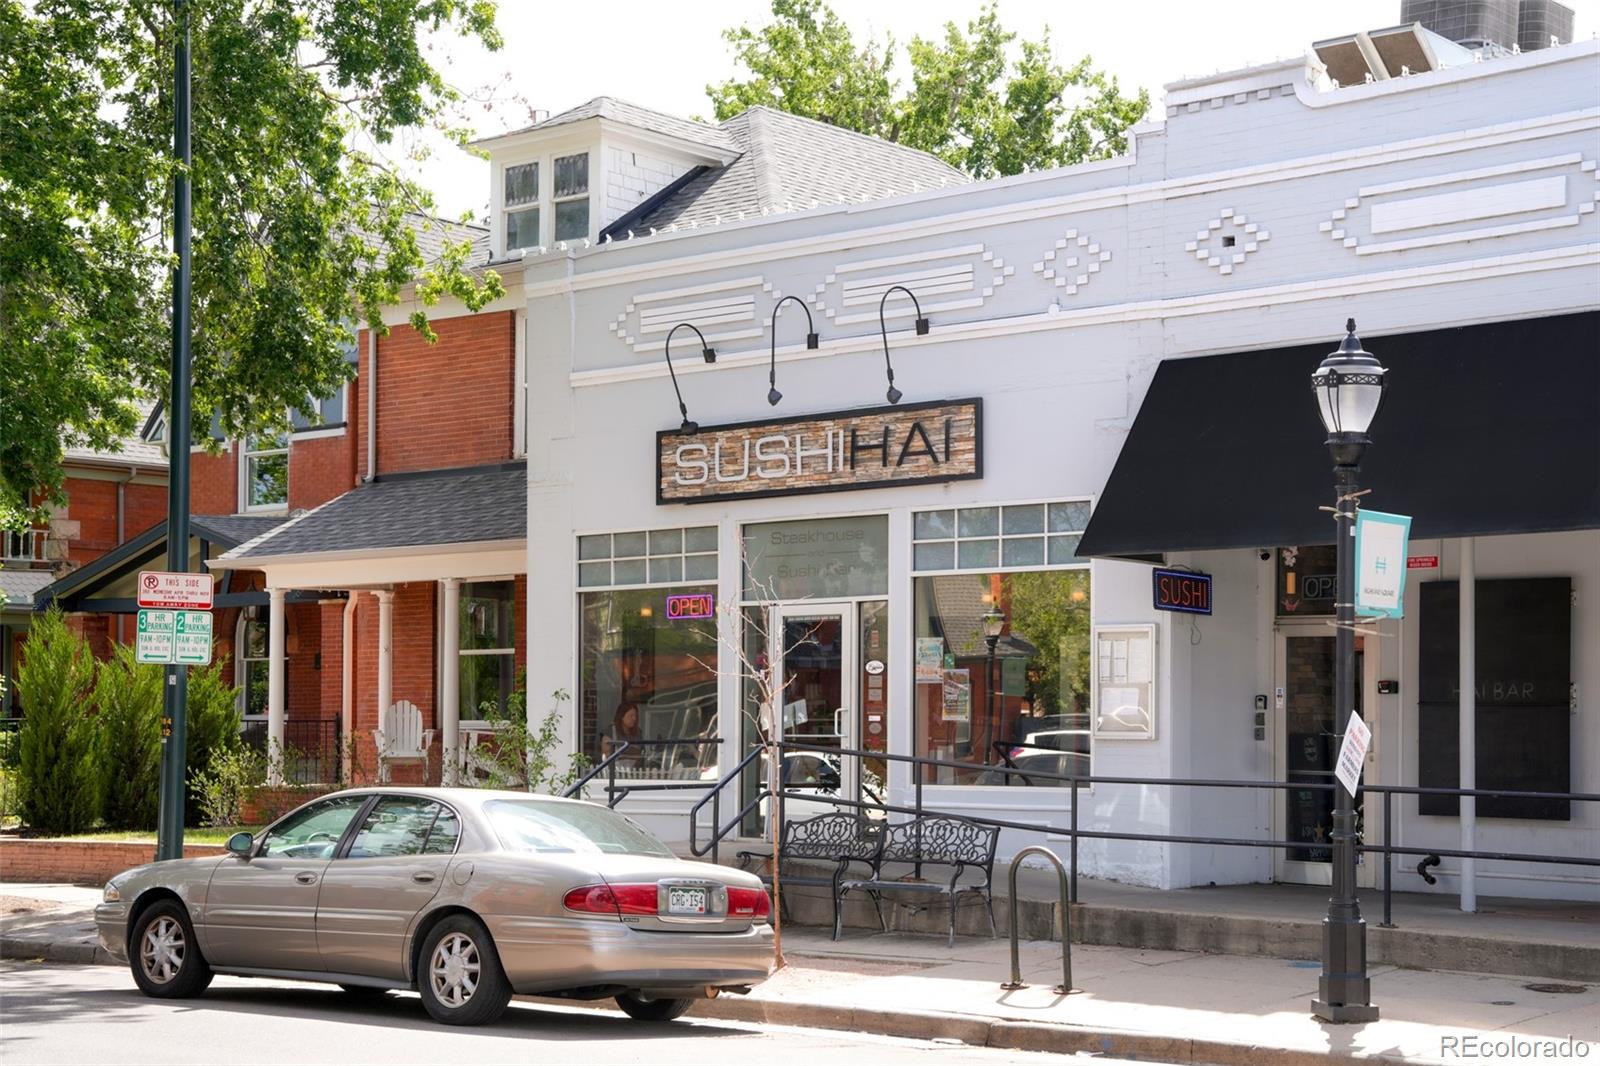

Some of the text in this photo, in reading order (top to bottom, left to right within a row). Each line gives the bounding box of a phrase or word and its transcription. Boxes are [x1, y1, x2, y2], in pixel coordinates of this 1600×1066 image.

[770, 528, 865, 545] Steakhouse
[165, 578, 199, 588] THIS SIDE
[1160, 577, 1207, 608] SUSHI
[669, 597, 710, 616] OPEN
[140, 613, 166, 629] 3 HR
[147, 622, 172, 631] PARKING
[177, 614, 203, 630] 2 HR
[184, 623, 210, 632] PARKING
[1493, 682, 1535, 701] BAR
